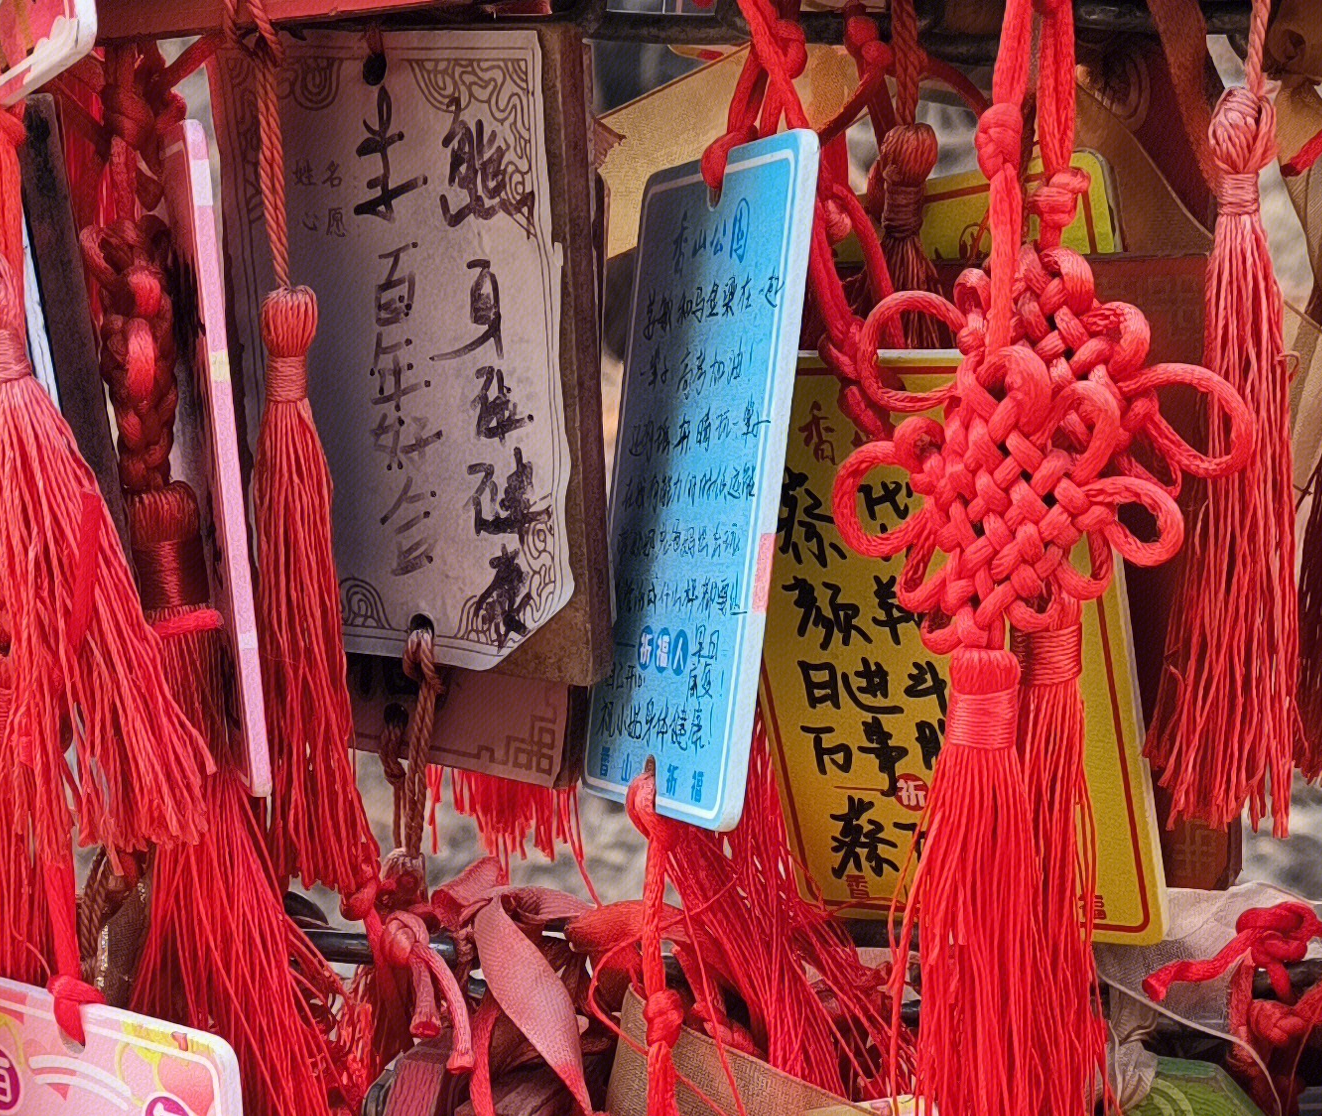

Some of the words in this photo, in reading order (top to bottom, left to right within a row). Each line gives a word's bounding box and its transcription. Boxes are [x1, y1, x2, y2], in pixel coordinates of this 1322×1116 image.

[672, 198, 751, 277] 香山公园
[639, 627, 688, 672] 祈福人
[665, 763, 705, 803] 祈福
